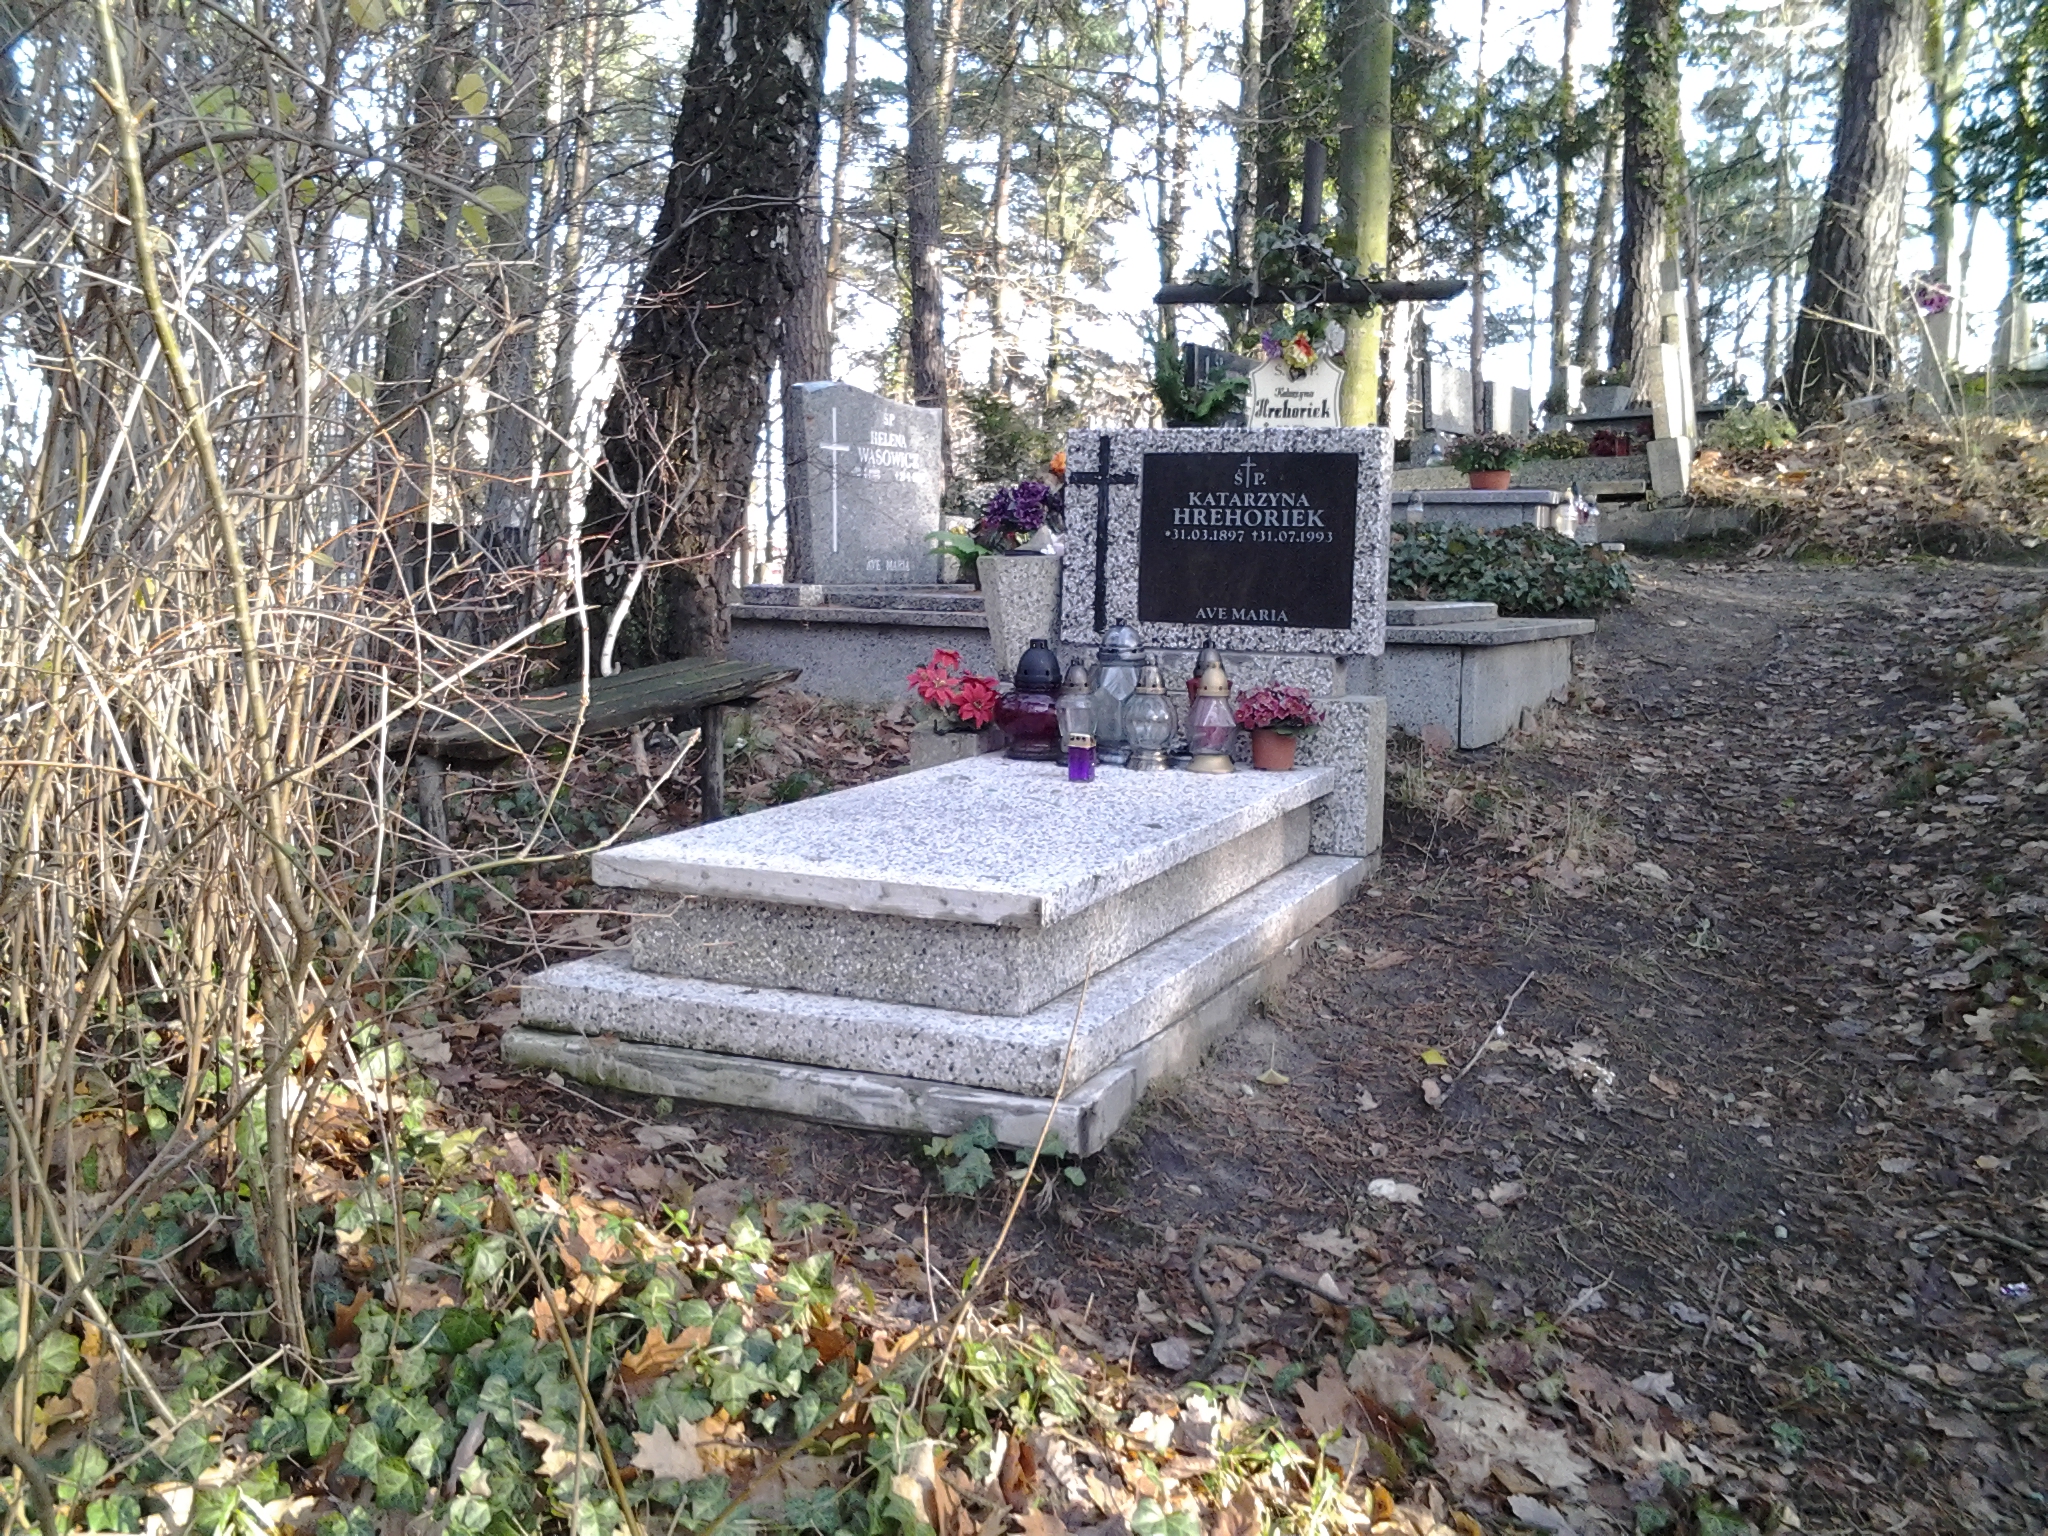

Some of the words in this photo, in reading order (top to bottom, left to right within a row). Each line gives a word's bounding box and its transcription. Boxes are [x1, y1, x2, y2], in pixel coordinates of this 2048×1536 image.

[871, 430, 907, 448] HELENA
[1188, 492, 1311, 507] KATARZYNA
[1173, 508, 1325, 528] HREHORIEK
[1195, 608, 1228, 620] AVE
[1232, 609, 1289, 622] MARIA
